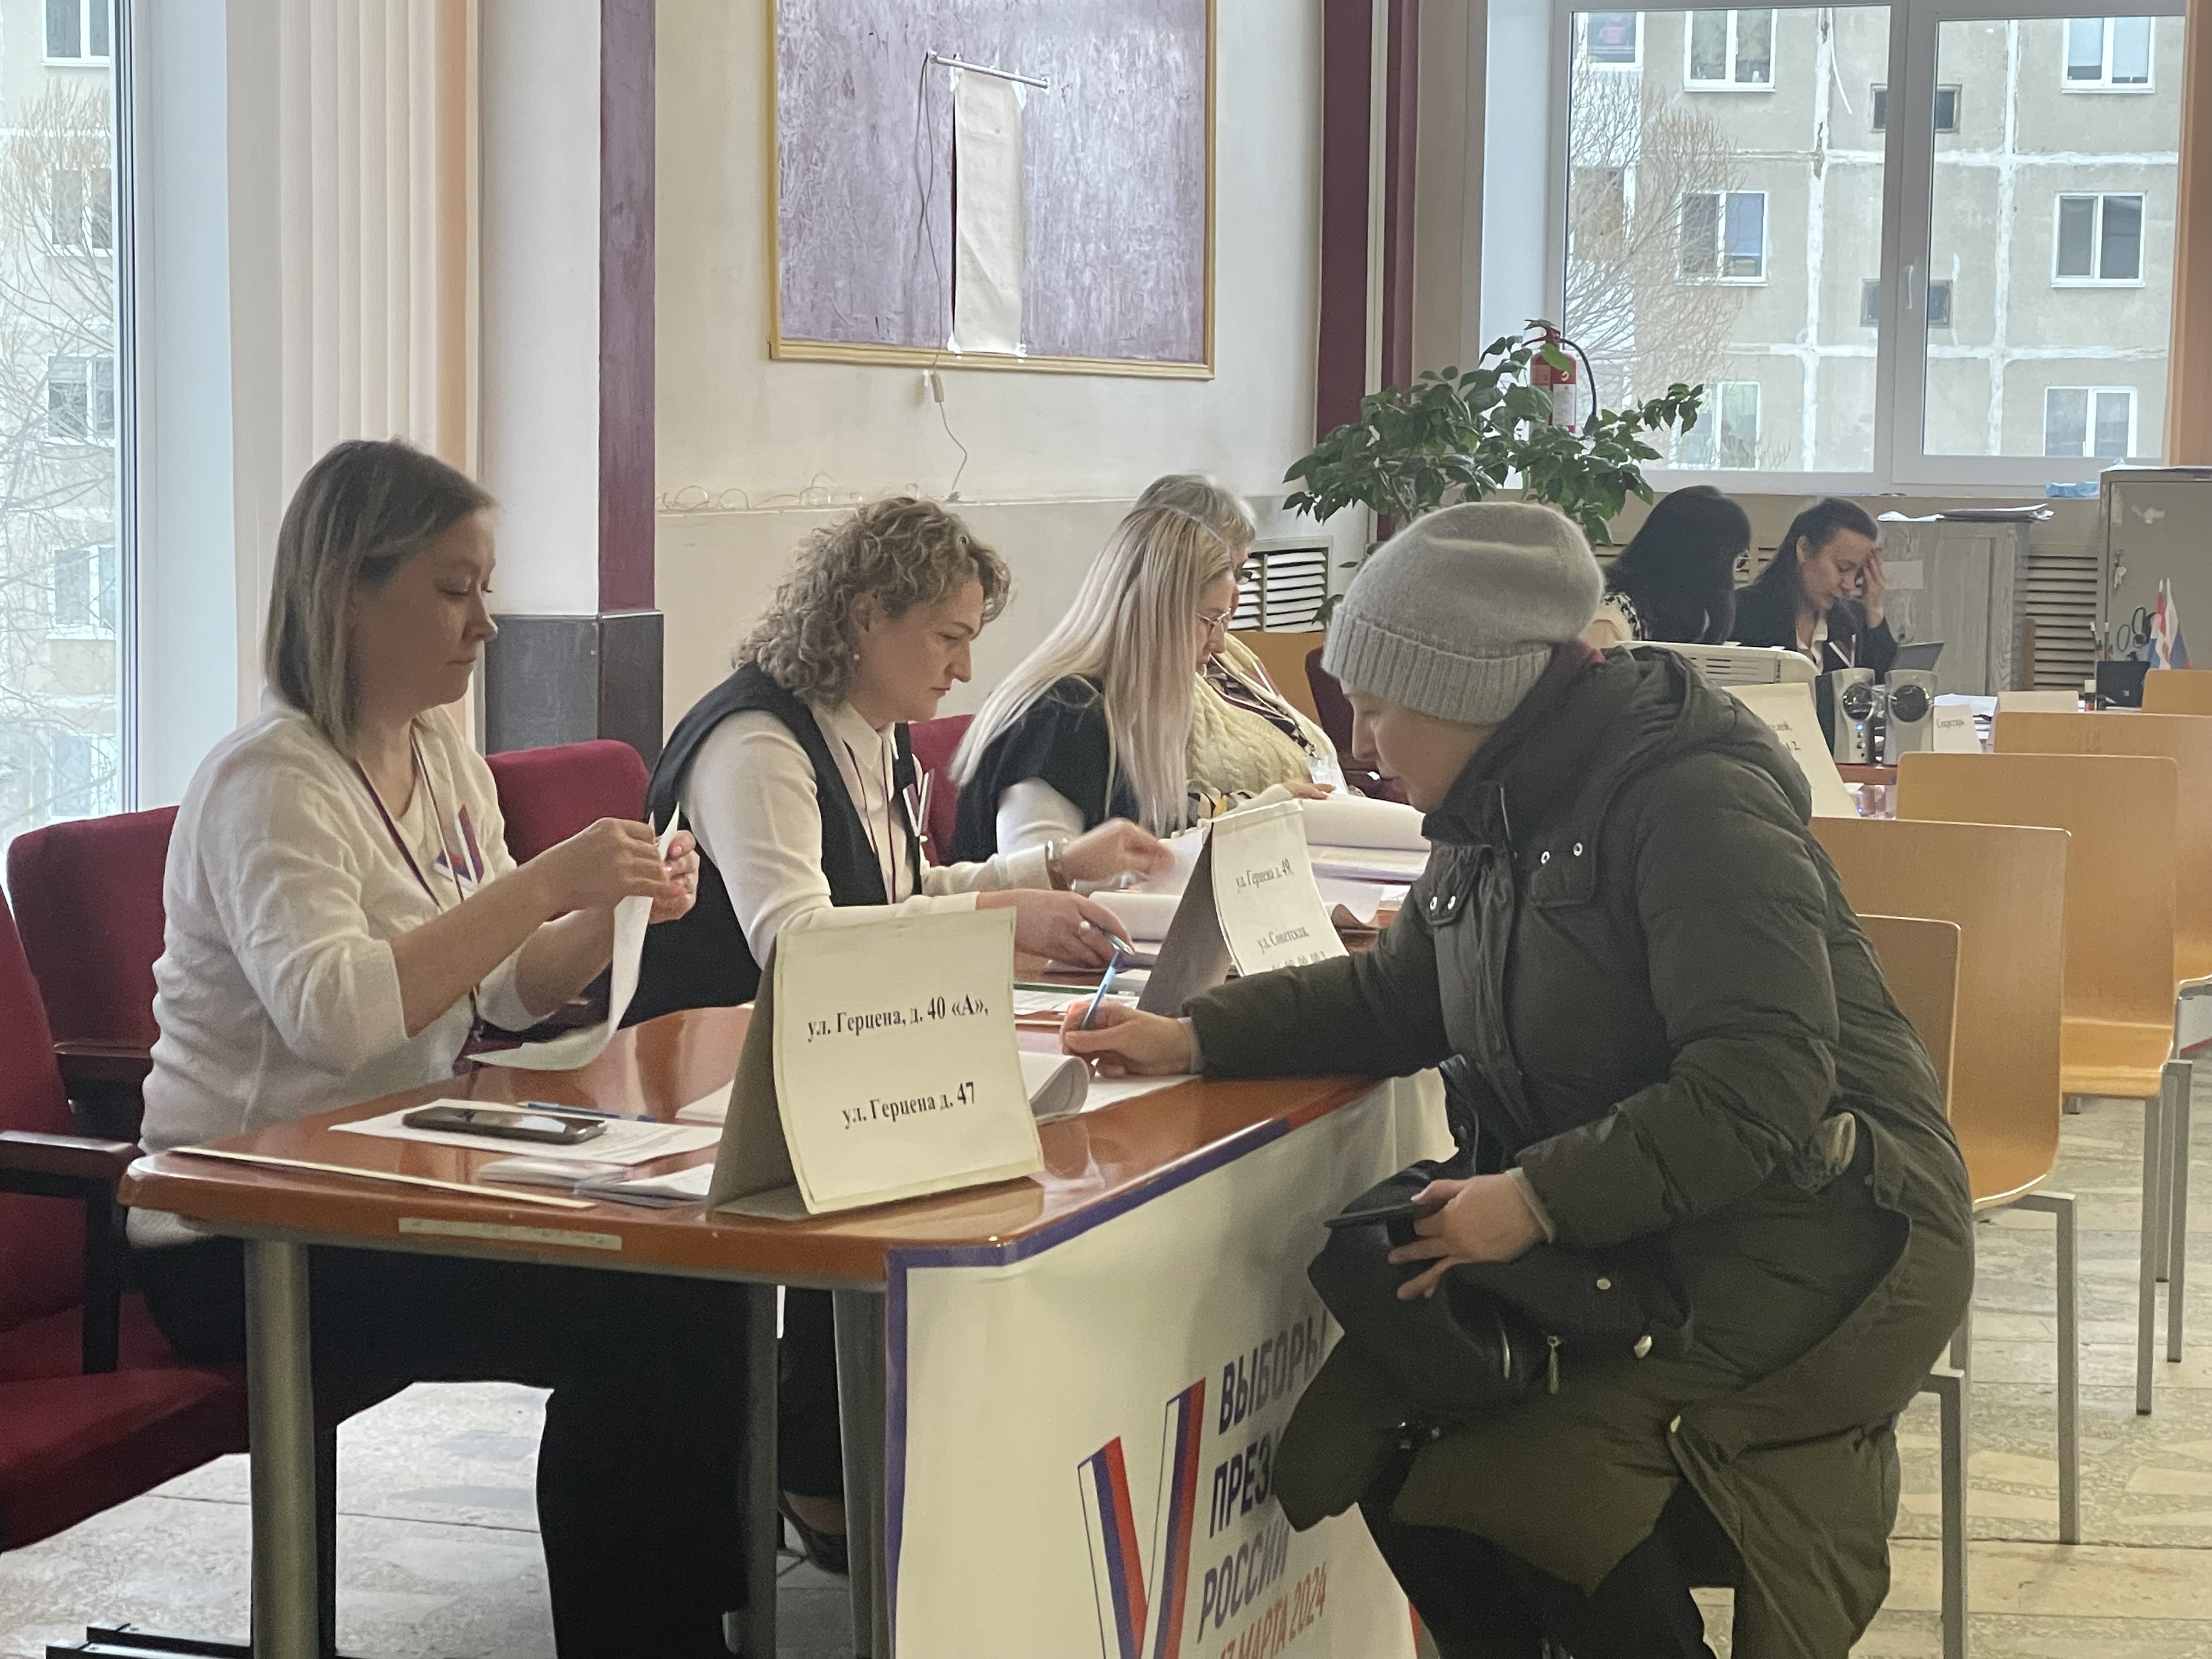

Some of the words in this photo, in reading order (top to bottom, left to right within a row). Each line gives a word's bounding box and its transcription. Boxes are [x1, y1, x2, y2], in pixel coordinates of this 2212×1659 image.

[1235, 876, 1247, 894] ул.
[1256, 938, 1271, 955] ул.
[808, 1020, 831, 1043] ул.
[837, 1010, 906, 1036] Герцена,
[910, 1007, 923, 1025] д.
[927, 996, 946, 1020] 40
[951, 994, 989, 1017] «А»,
[842, 1107, 866, 1130] ул.
[870, 1096, 936, 1122] Герцена
[940, 1093, 954, 1111] д.
[957, 1081, 975, 1105] 47
[1218, 1308, 1328, 1435] ВЫБОРЫ
[1209, 1429, 1280, 1539] ПРЕЗ
[1197, 1517, 1289, 1645] РОССИИ
[1289, 1561, 1327, 1640] 2024
